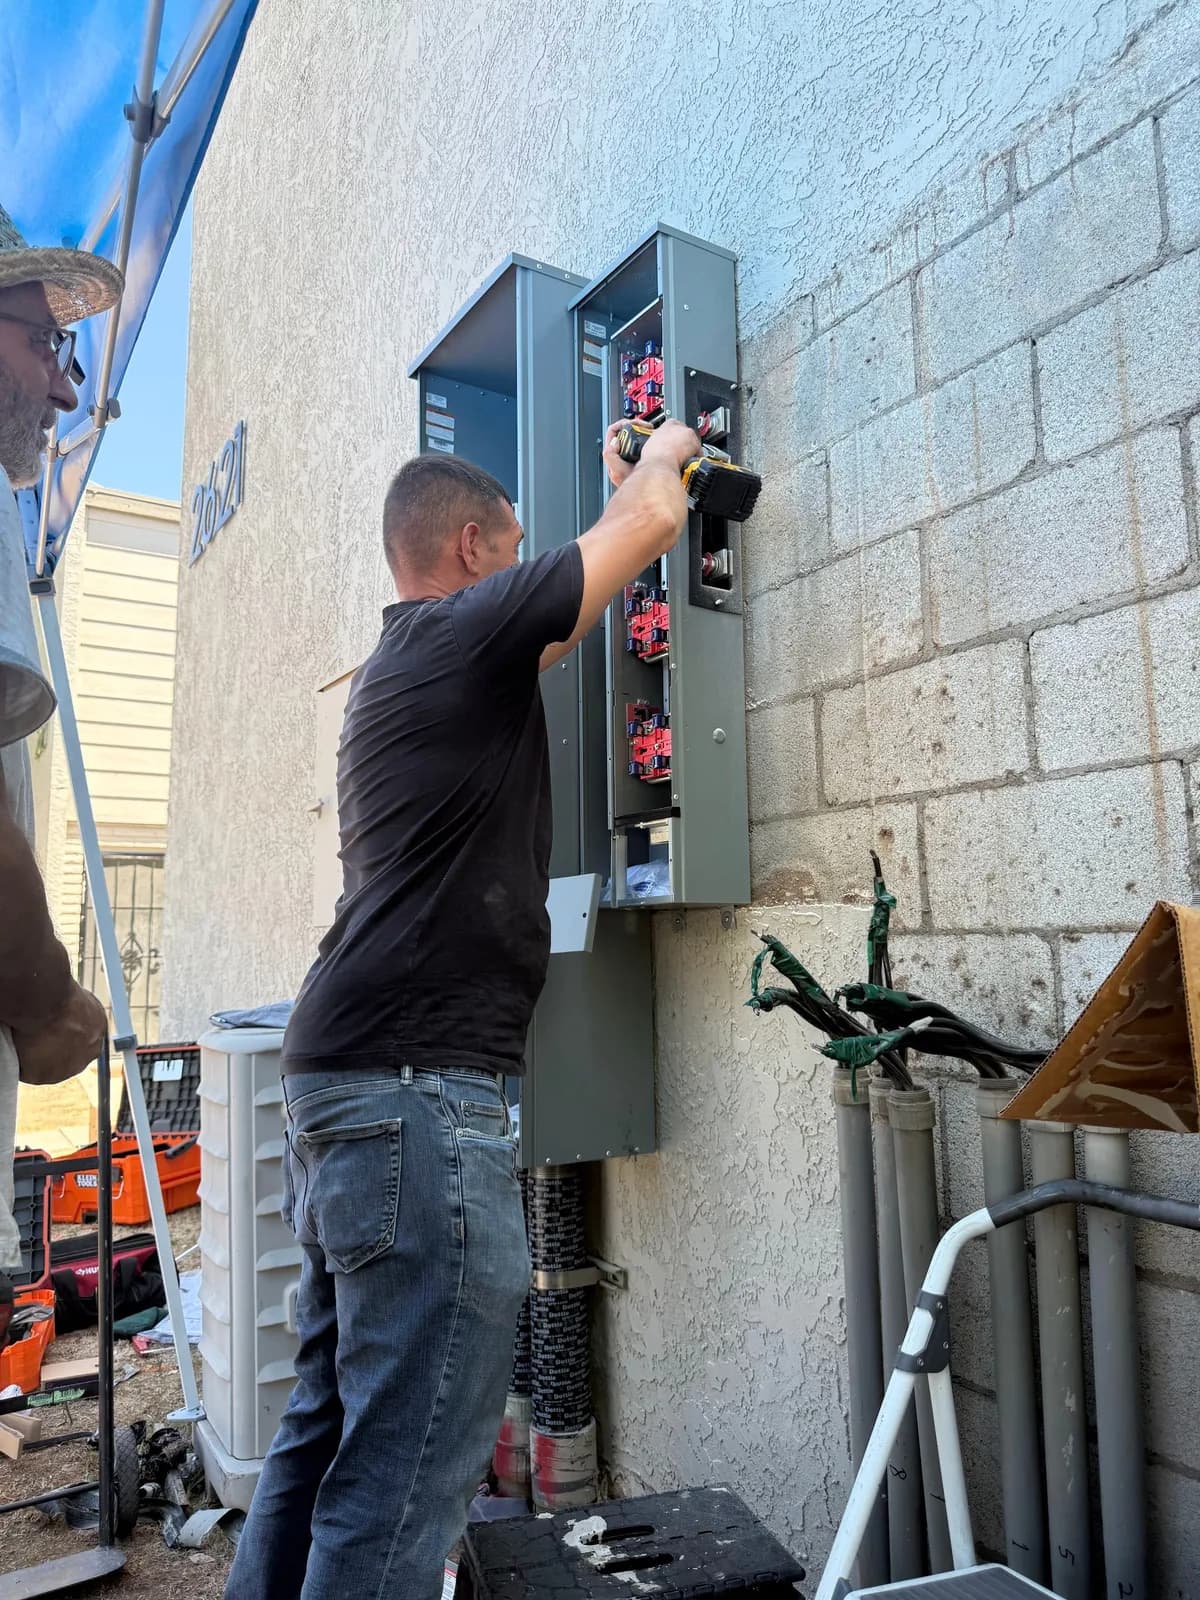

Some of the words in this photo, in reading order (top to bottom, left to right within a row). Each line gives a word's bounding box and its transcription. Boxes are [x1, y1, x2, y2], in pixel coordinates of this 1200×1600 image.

[189, 418, 246, 568] 2621
[889, 1464, 907, 1480] 8
[1058, 1545, 1075, 1566] 5
[1118, 1582, 1134, 1600] 2
